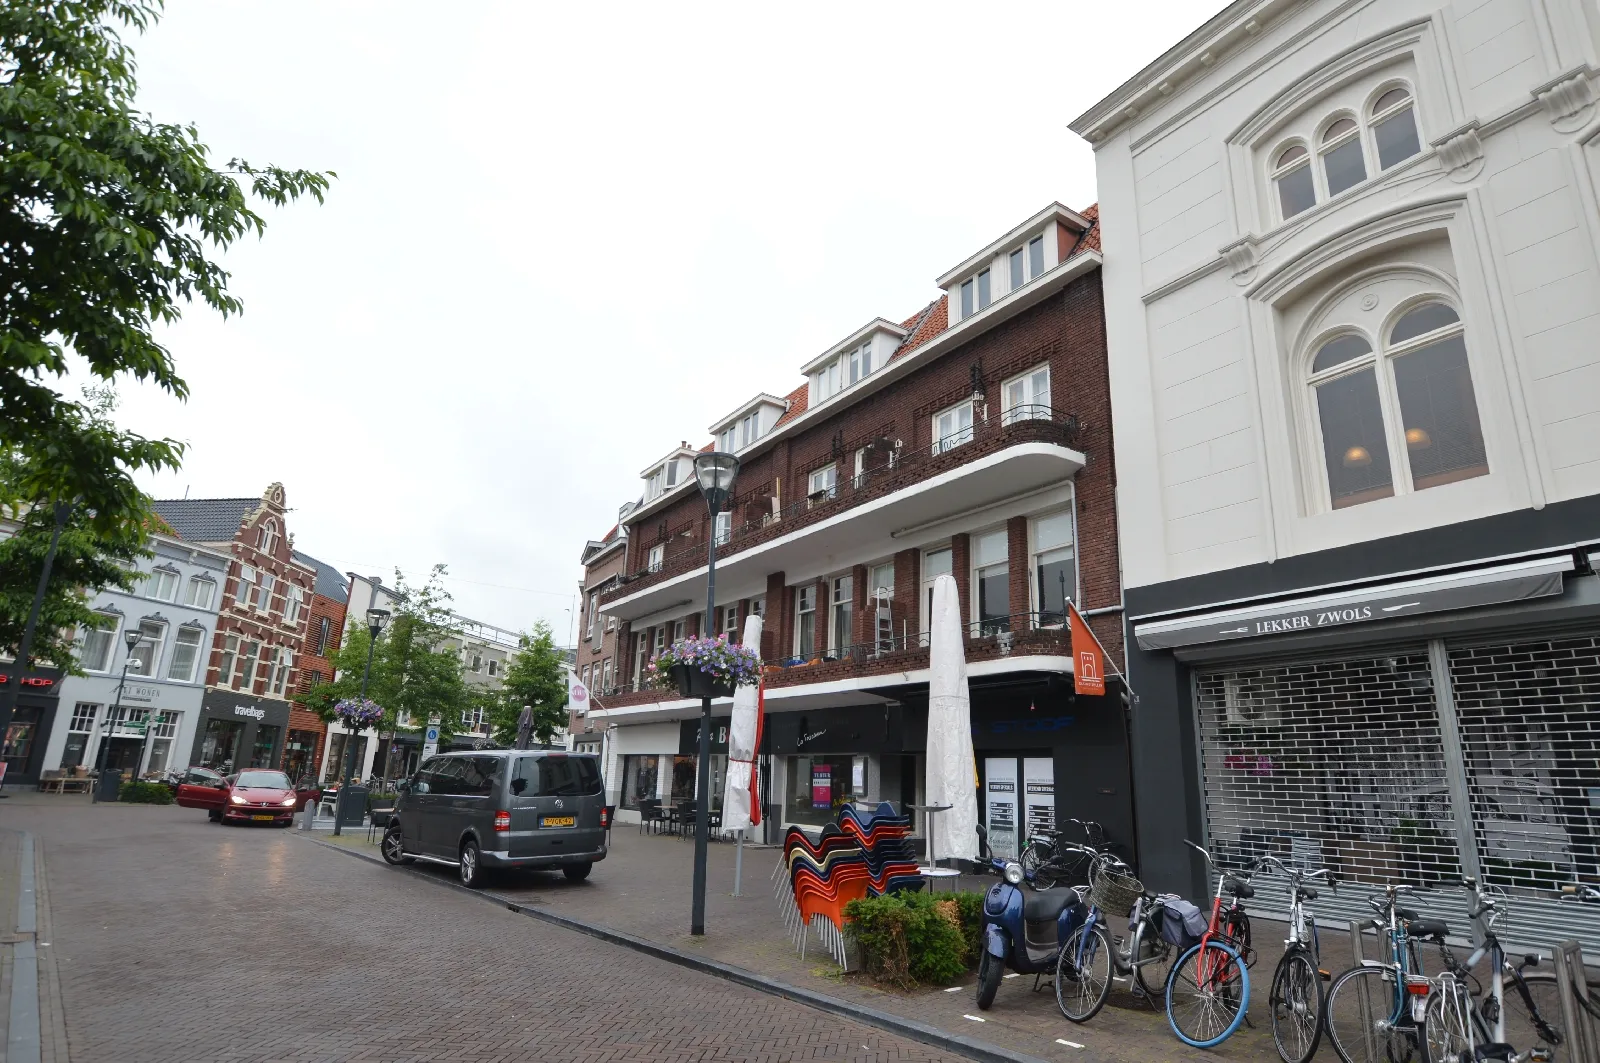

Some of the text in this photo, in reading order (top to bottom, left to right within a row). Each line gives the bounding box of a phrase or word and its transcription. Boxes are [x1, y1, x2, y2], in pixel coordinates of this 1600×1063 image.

[1256, 606, 1372, 633] LEKKER ZWOLS
[234, 705, 266, 720] travelbags
